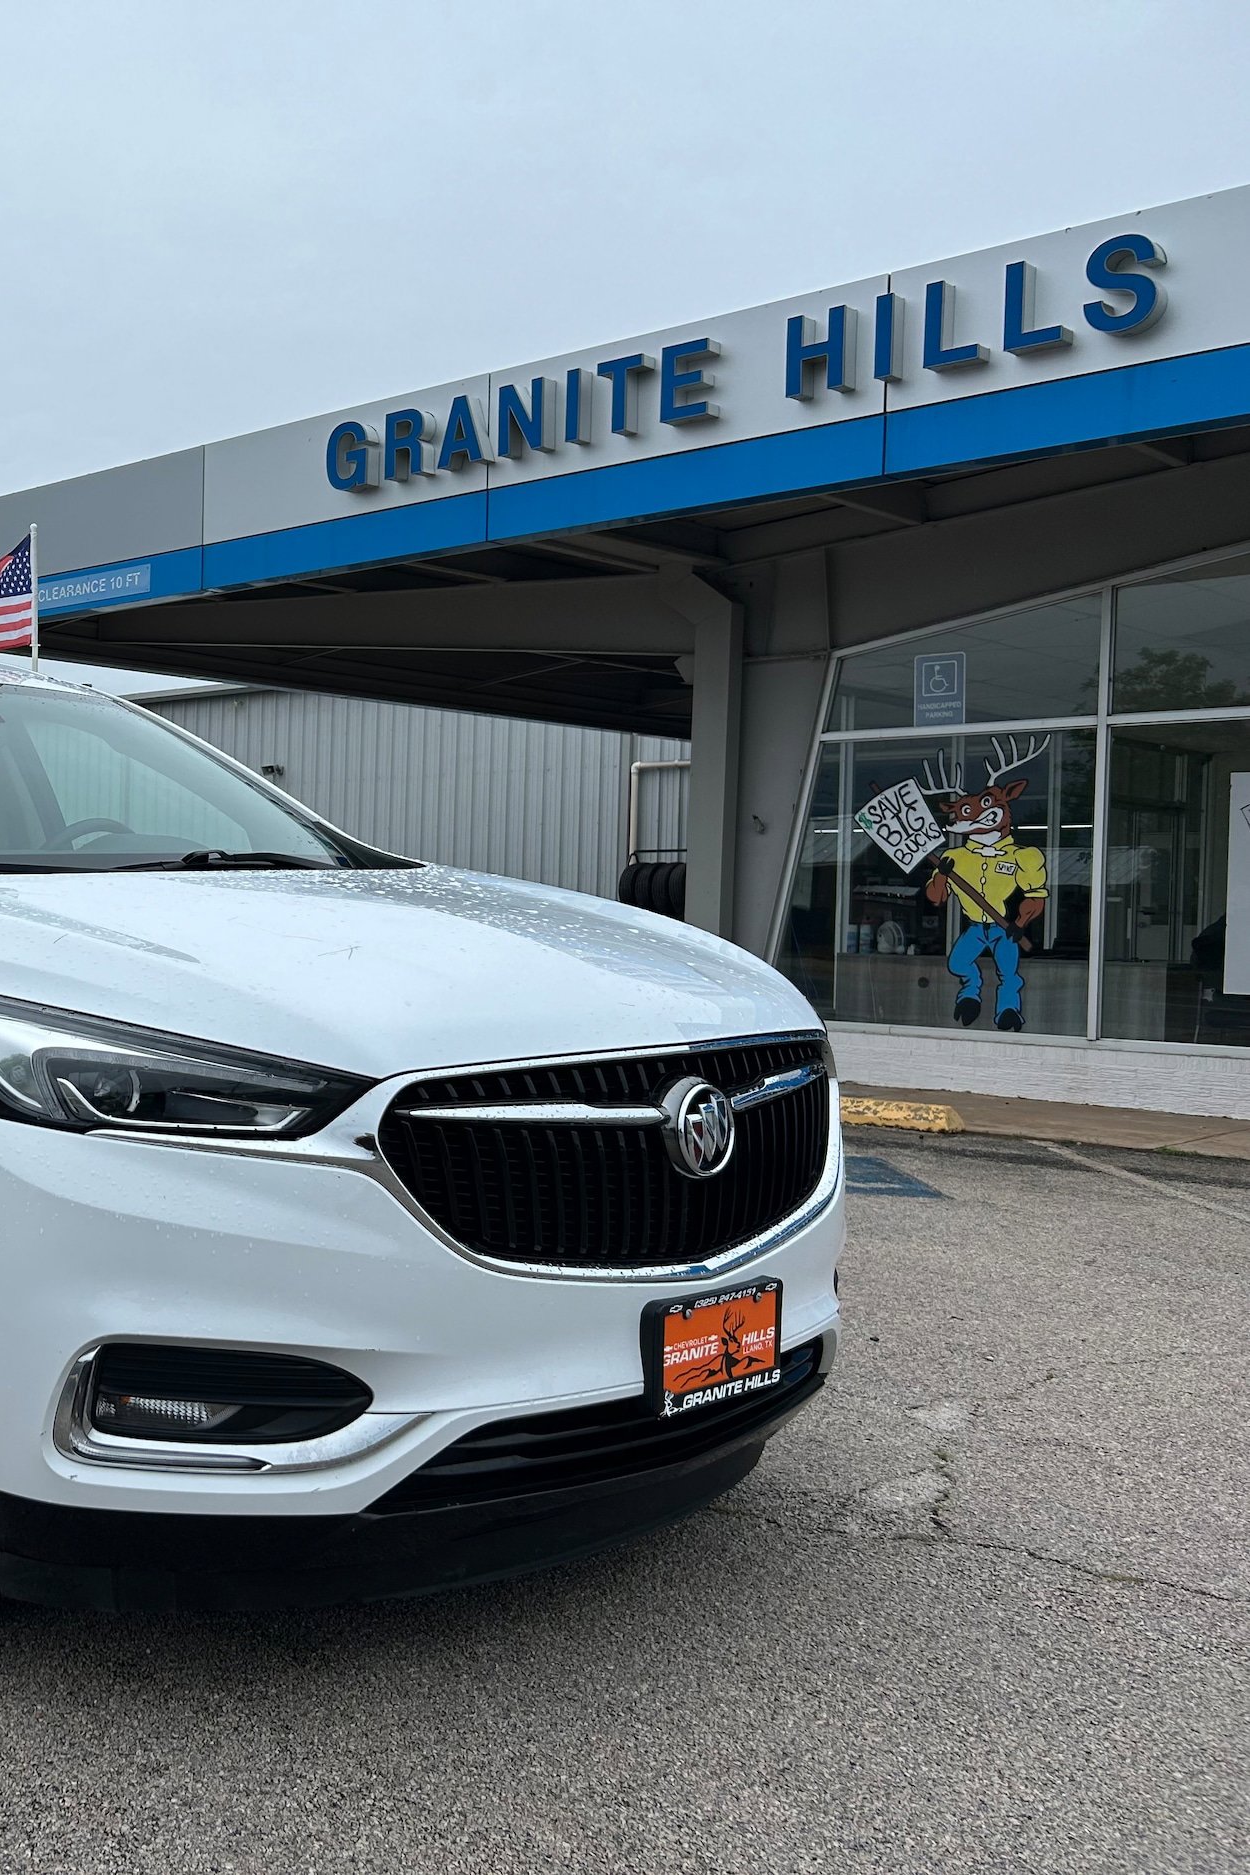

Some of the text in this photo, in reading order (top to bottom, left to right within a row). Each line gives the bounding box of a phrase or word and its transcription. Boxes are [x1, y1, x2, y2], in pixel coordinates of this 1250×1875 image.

[326, 233, 1168, 493] GRANITE HILLS
[38, 572, 141, 602] CLEARANCE 10 FT
[918, 701, 962, 710] HANDICAPPED
[876, 806, 925, 847] BIG
[893, 822, 941, 866] BUCKS
[694, 1296, 718, 1308] (325)
[663, 1326, 776, 1367] GRANITE HILLS
[673, 1336, 708, 1351] CHEVROLET
[764, 1340, 773, 1349] TX
[683, 1369, 781, 1409] GRANITE HILLS
